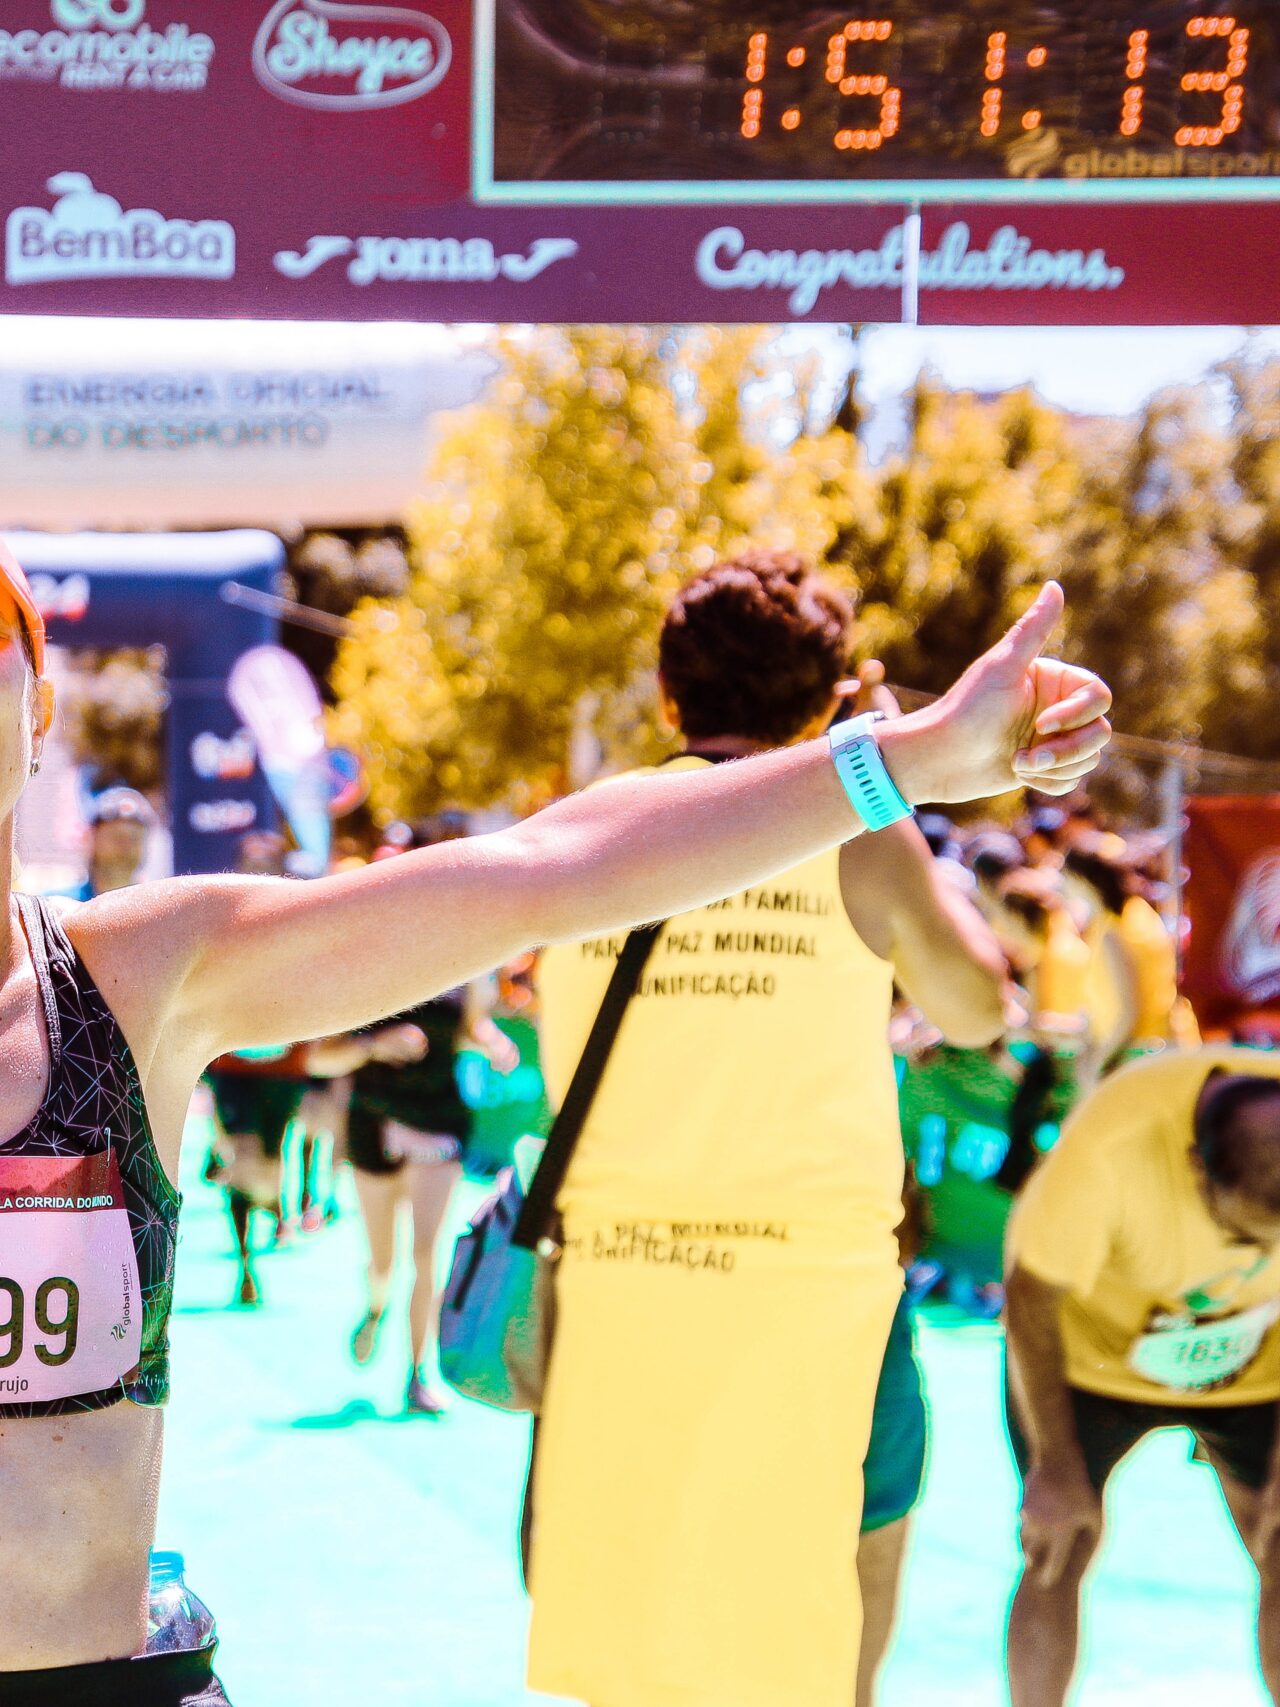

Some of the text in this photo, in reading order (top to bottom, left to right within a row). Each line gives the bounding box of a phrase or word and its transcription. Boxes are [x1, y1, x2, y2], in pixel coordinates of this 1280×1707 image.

[19, 218, 225, 261] BemBoa
[348, 235, 498, 285] joma
[667, 931, 704, 954] PAZ
[714, 931, 818, 957] MUNDIAL
[15, 1196, 74, 1209] CORRIDA
[121, 1263, 131, 1327] globalsport
